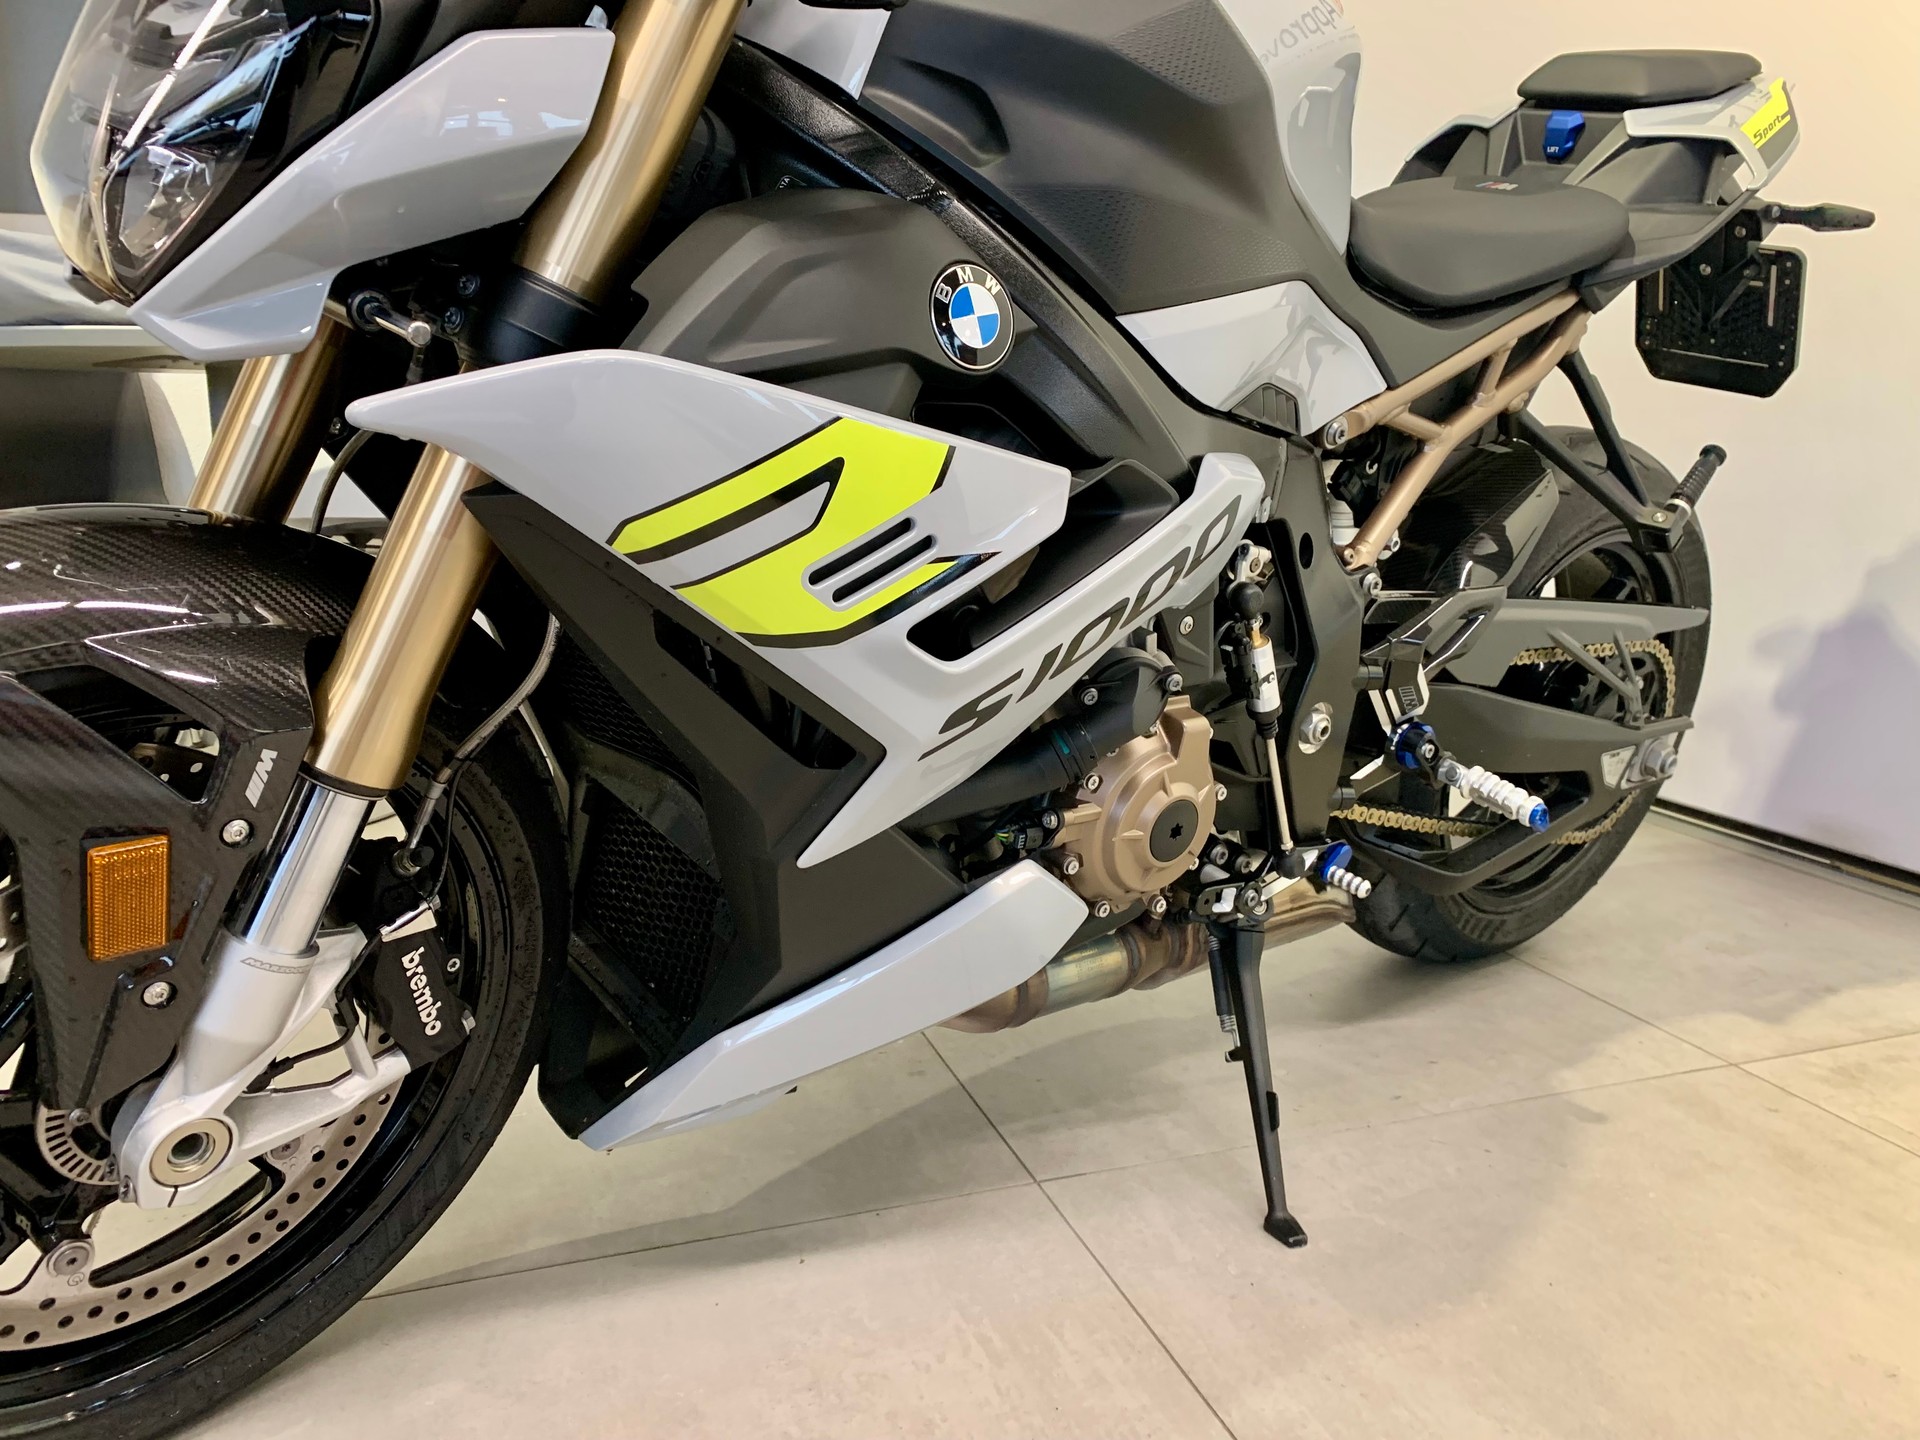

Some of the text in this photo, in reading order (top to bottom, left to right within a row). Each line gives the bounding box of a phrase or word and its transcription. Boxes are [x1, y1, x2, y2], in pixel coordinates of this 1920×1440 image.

[1753, 115, 1783, 146] Sport
[935, 266, 1001, 304] BMW
[917, 494, 1242, 762] S1000
[401, 946, 442, 1036] brembo
